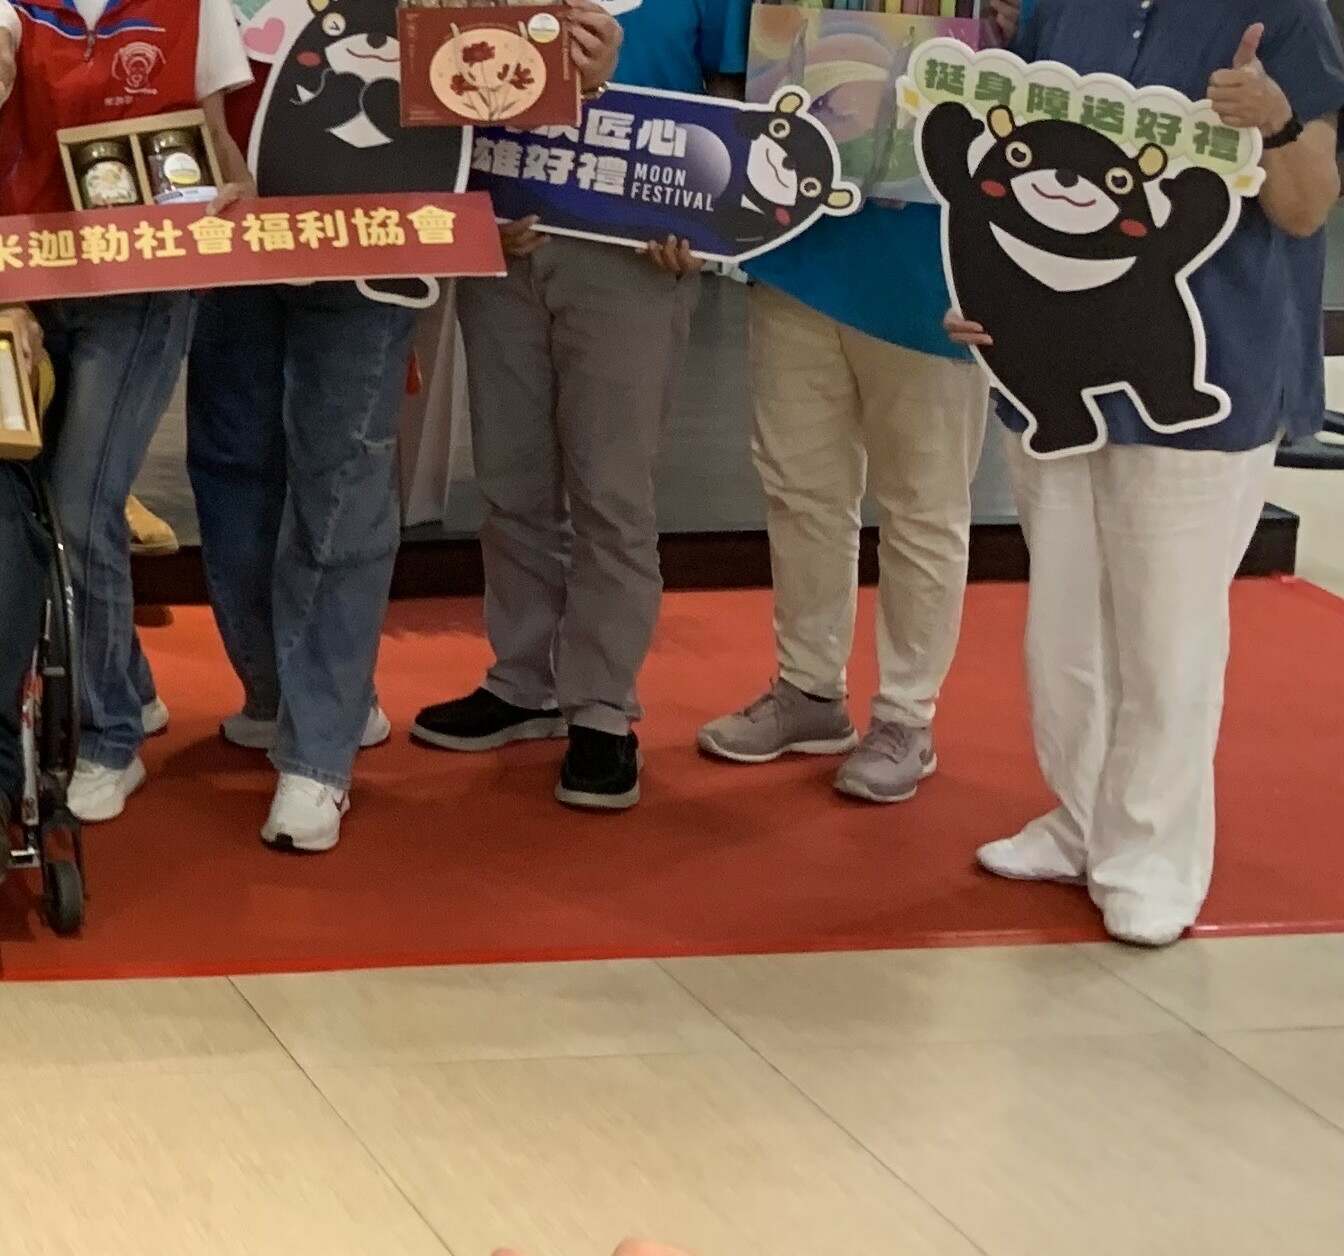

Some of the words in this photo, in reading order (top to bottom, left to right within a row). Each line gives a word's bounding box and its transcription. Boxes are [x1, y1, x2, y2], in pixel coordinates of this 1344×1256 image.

[925, 58, 1240, 163] 挺身障送好禮
[472, 137, 628, 195] 雄好禮
[633, 163, 687, 187] MOON
[631, 182, 715, 212] FESTIVAL
